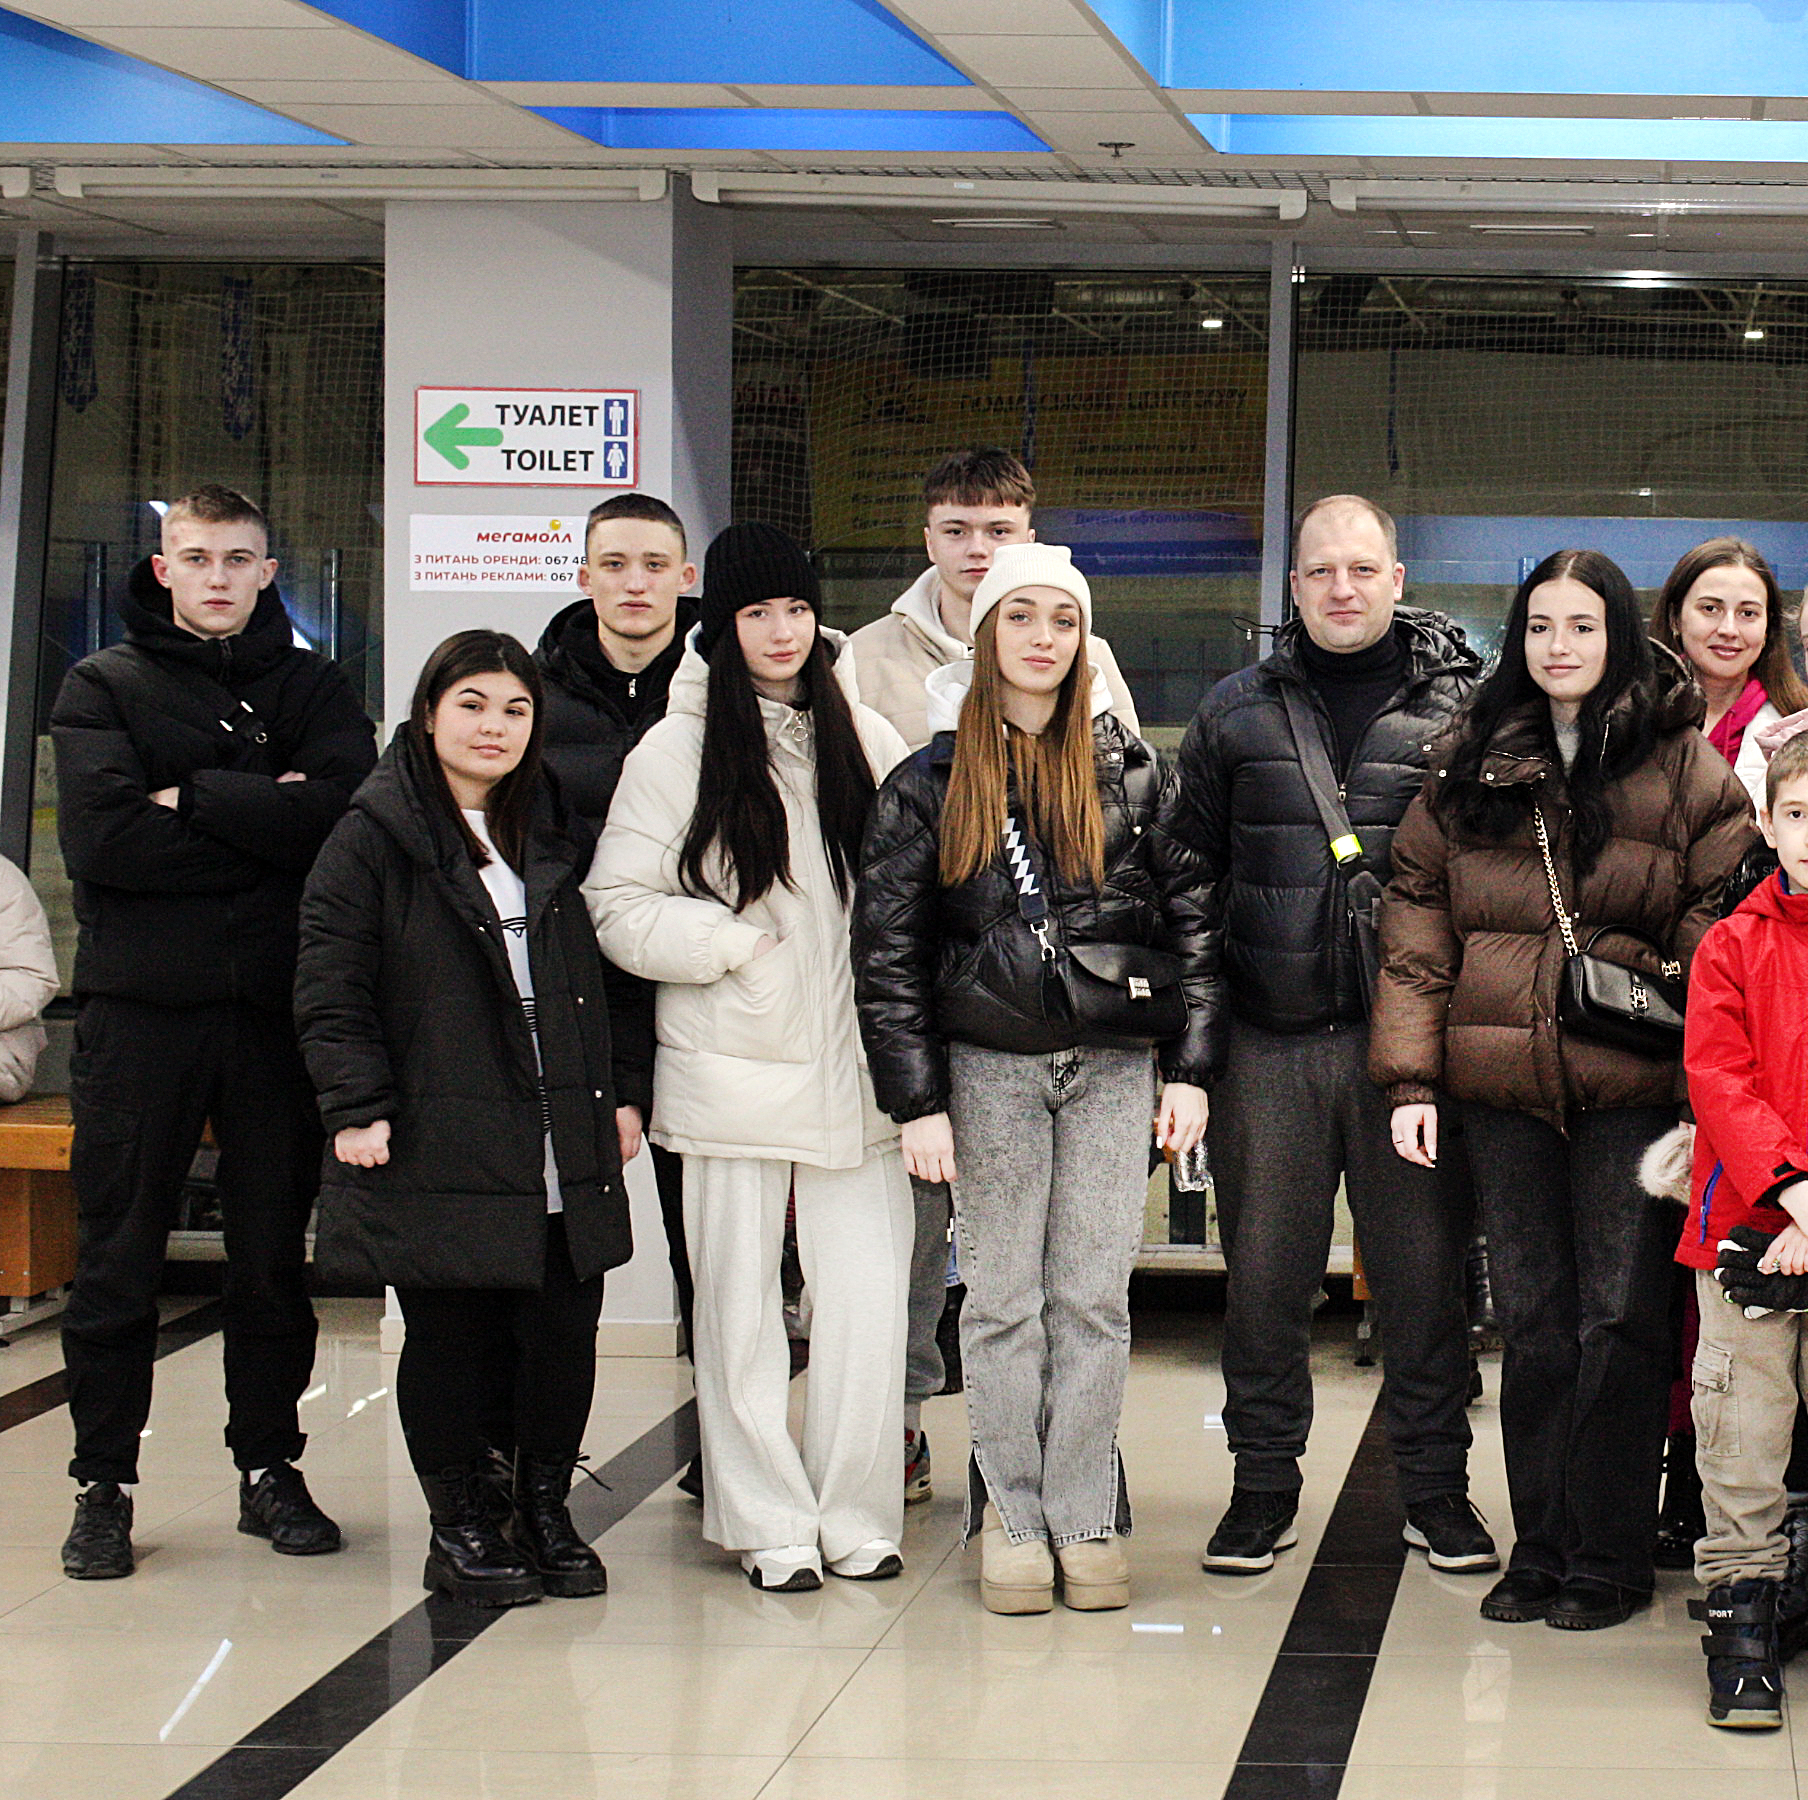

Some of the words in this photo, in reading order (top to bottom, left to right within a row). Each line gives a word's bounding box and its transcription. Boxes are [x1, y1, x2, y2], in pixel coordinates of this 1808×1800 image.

[495, 404, 599, 426] ТУАЛЕТ
[501, 449, 595, 471] TOILET
[476, 532, 572, 543] мегамолл
[425, 555, 479, 564] ПИТАНЬ
[483, 555, 541, 566] ОРЕНДИ:
[545, 556, 569, 565] 067
[425, 572, 477, 581] ПИТАНЬ
[481, 572, 547, 581] РЕКЛАМИ:
[551, 573, 574, 581] 067
[1708, 1609, 1734, 1618] SPORT
